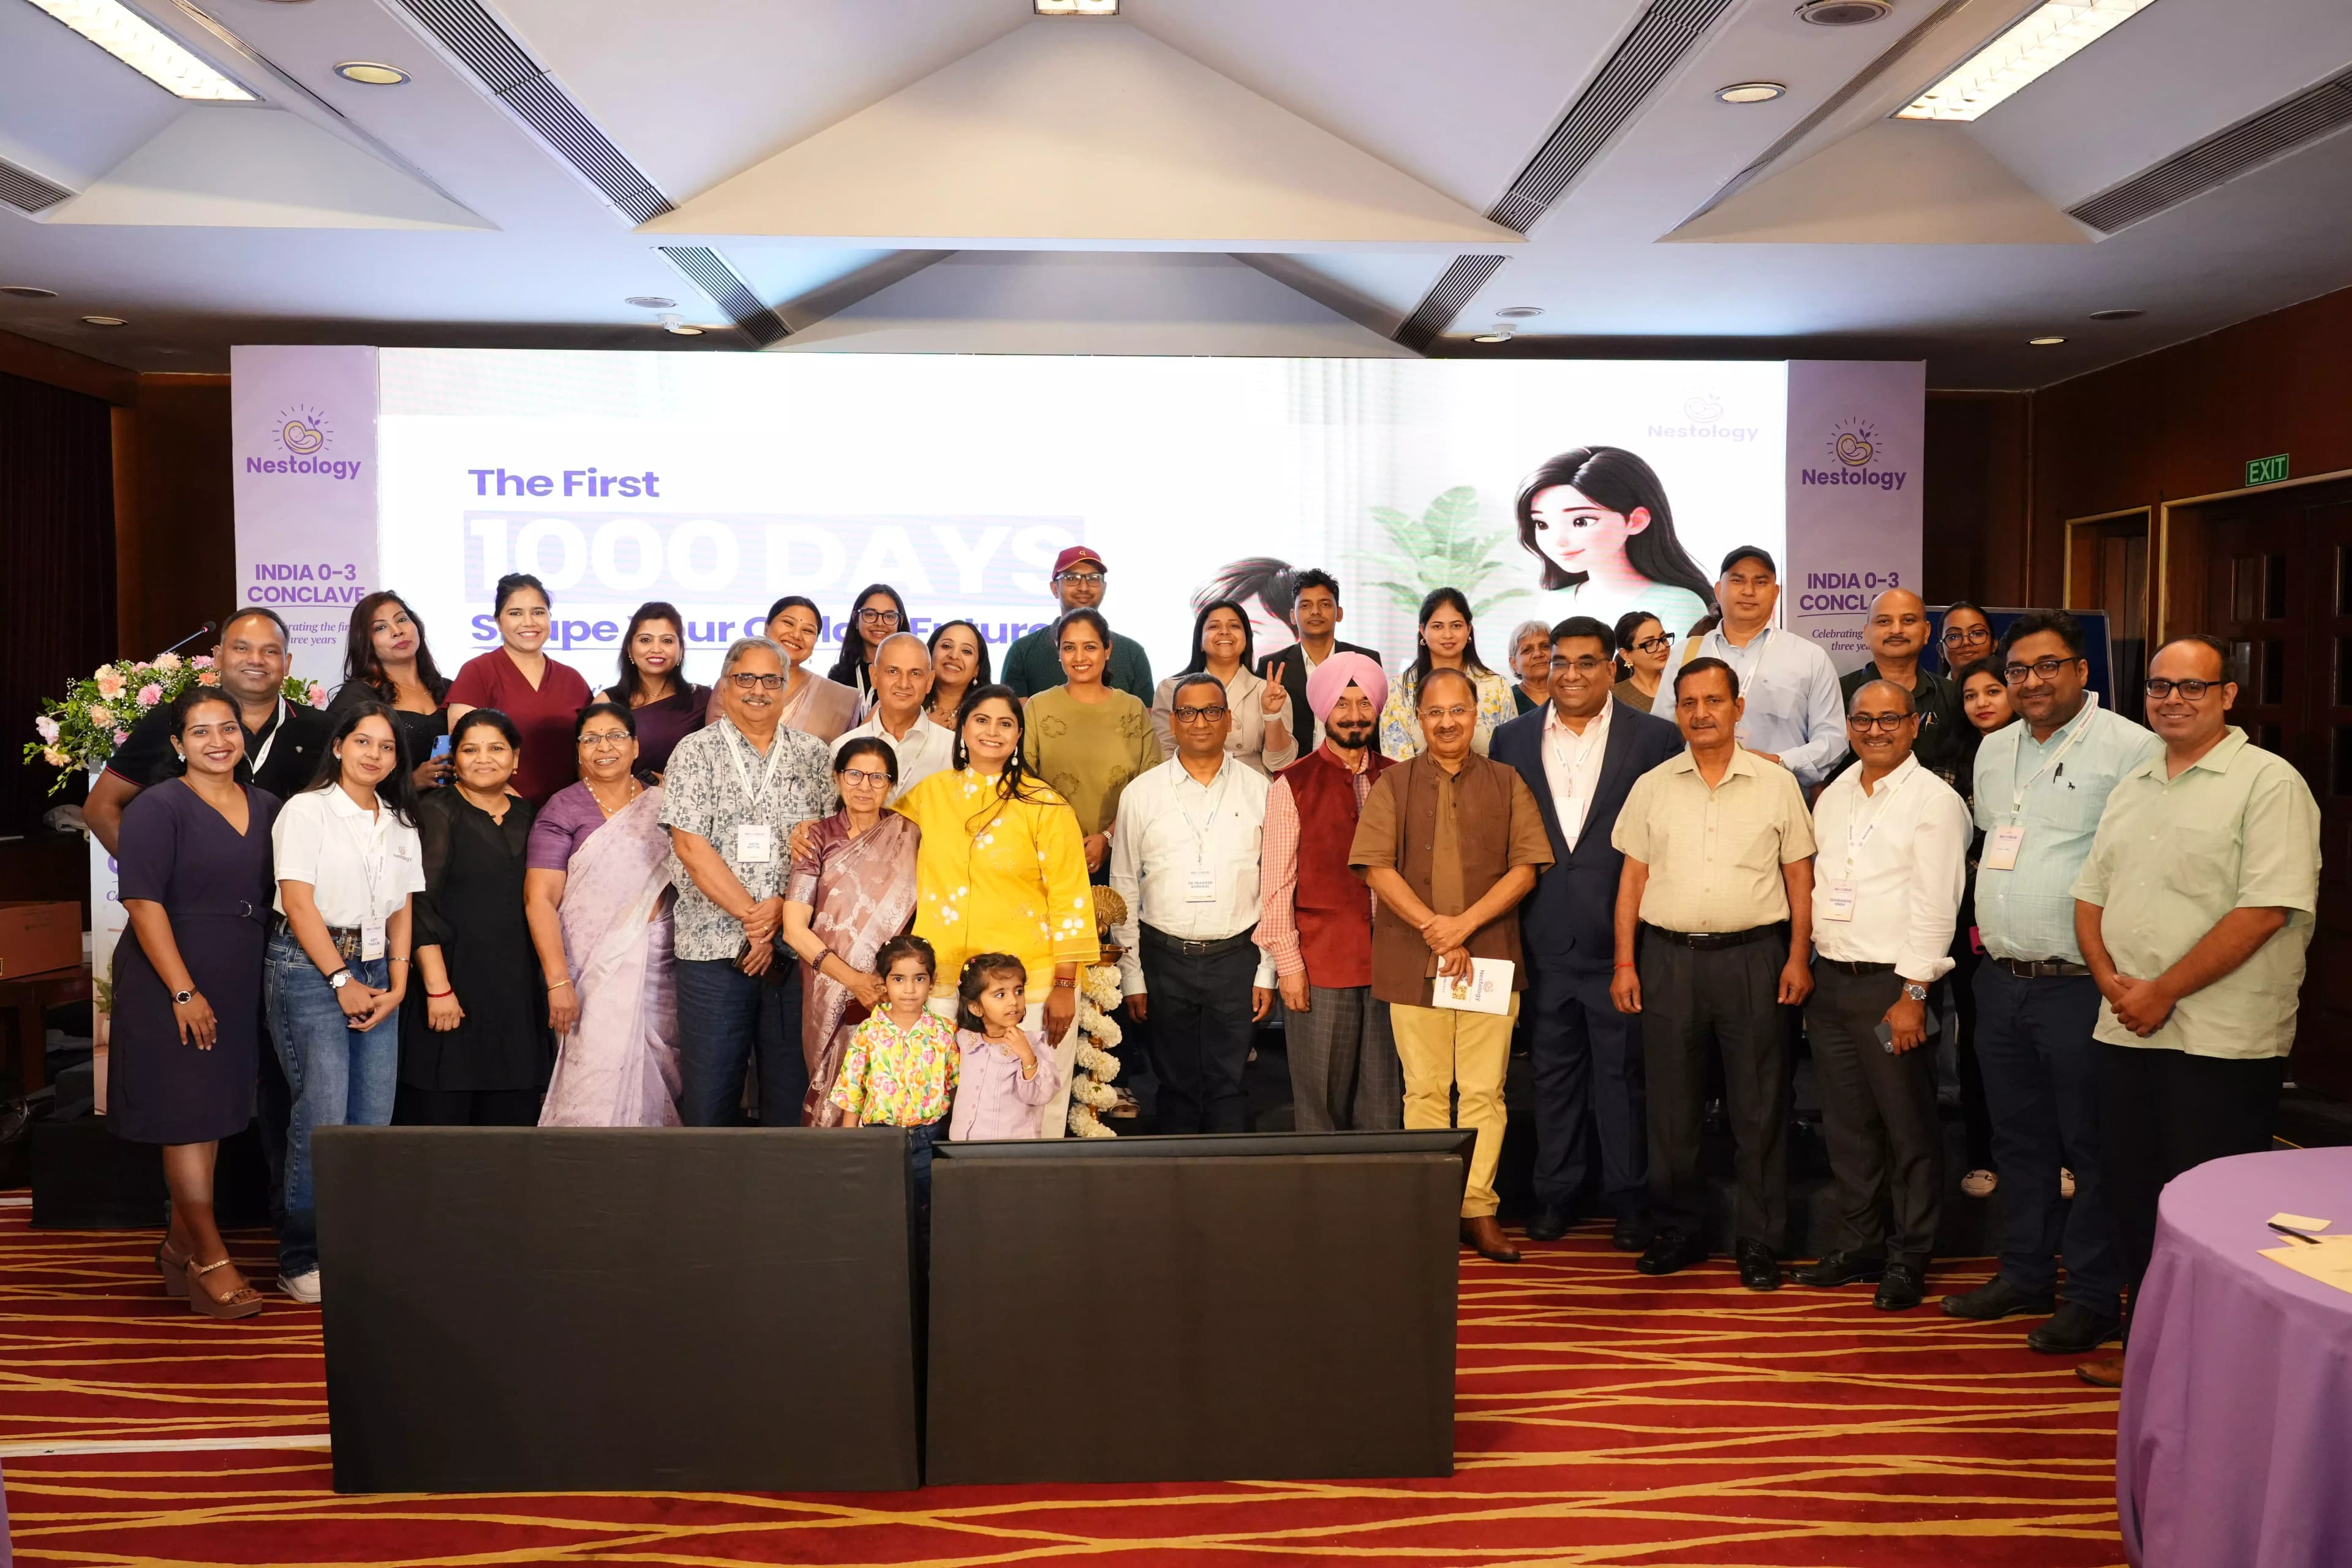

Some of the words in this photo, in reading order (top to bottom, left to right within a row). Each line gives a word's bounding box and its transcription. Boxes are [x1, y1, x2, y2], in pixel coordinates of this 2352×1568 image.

[1648, 423, 1758, 442] Nestology
[247, 454, 361, 480] Nestology
[2249, 456, 2286, 483] EXIT
[468, 469, 554, 497] The
[563, 467, 660, 497] First
[1802, 466, 1906, 491] Nestology
[470, 518, 739, 592] 1000
[765, 524, 1077, 597] DAYS
[255, 564, 314, 581] INDIA
[1807, 573, 1861, 589] INDIA
[247, 586, 366, 603] CONCLAVE
[1800, 594, 1878, 611] CONCL
[320, 622, 336, 631] the
[1812, 628, 1863, 640] Celebrating
[309, 636, 337, 647] years
[1831, 641, 1855, 651] three
[1475, 970, 1485, 1002] Nestology
